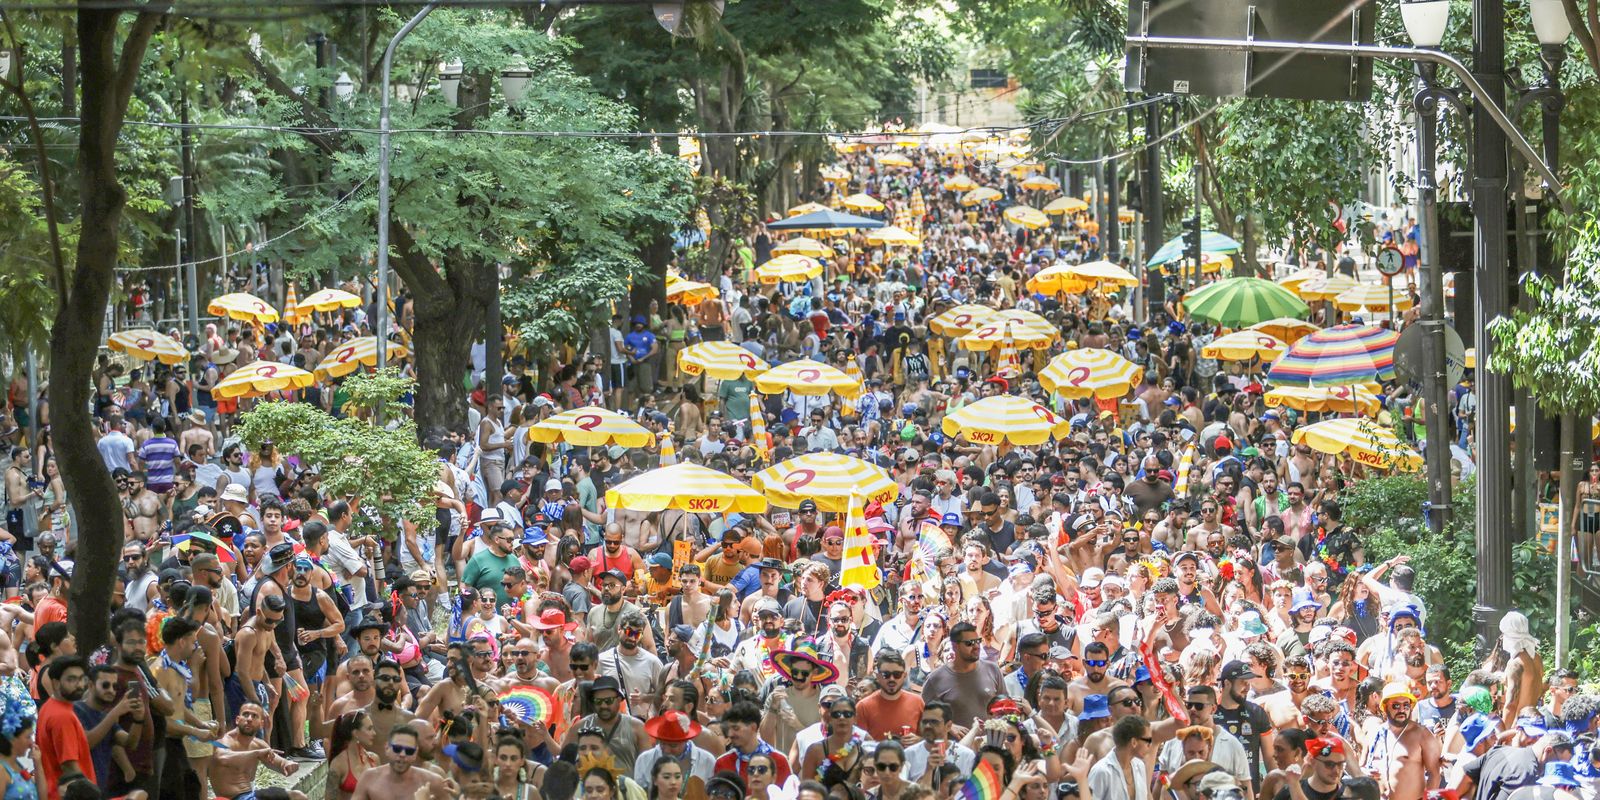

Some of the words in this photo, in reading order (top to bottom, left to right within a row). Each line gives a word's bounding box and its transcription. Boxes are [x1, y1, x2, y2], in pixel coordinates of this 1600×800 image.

[971, 431, 995, 442] SKOL
[1357, 451, 1382, 465] SKOL
[874, 491, 893, 504] SKOL
[688, 498, 719, 510] SKOL
